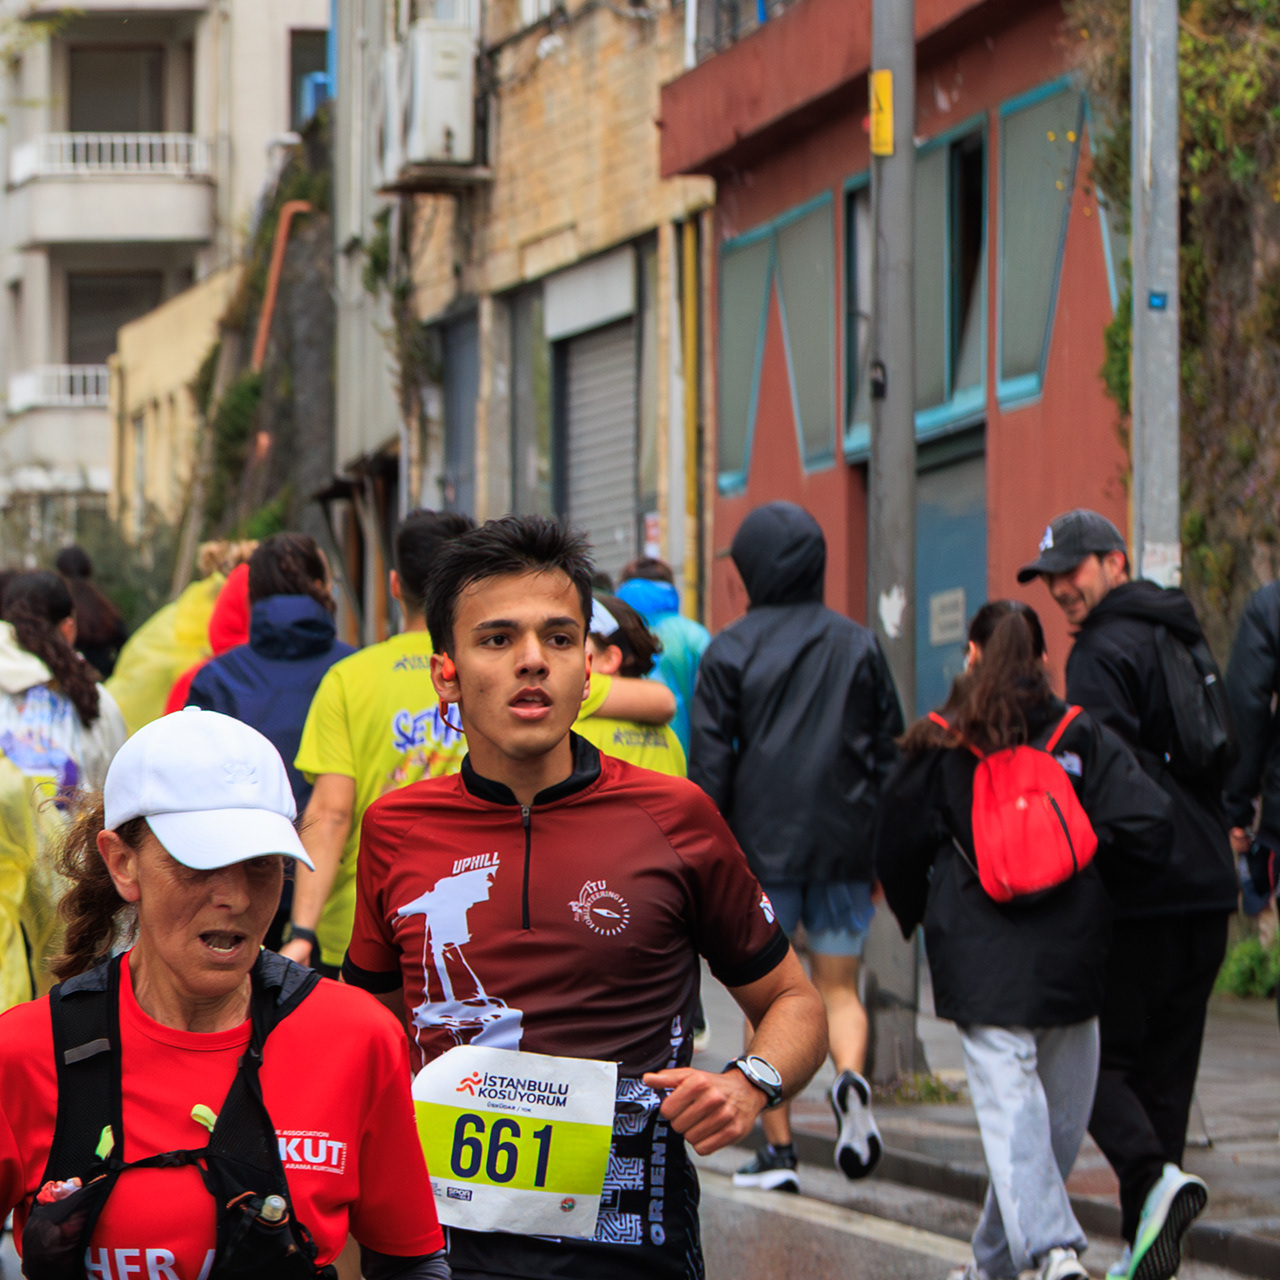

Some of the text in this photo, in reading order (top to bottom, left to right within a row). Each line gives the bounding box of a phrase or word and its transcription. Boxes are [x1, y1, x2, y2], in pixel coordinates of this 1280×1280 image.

[452, 852, 500, 874] UPHILL
[483, 1072, 569, 1095] İSTANBULU
[278, 1137, 344, 1166] KUT
[450, 1113, 553, 1188] 661
